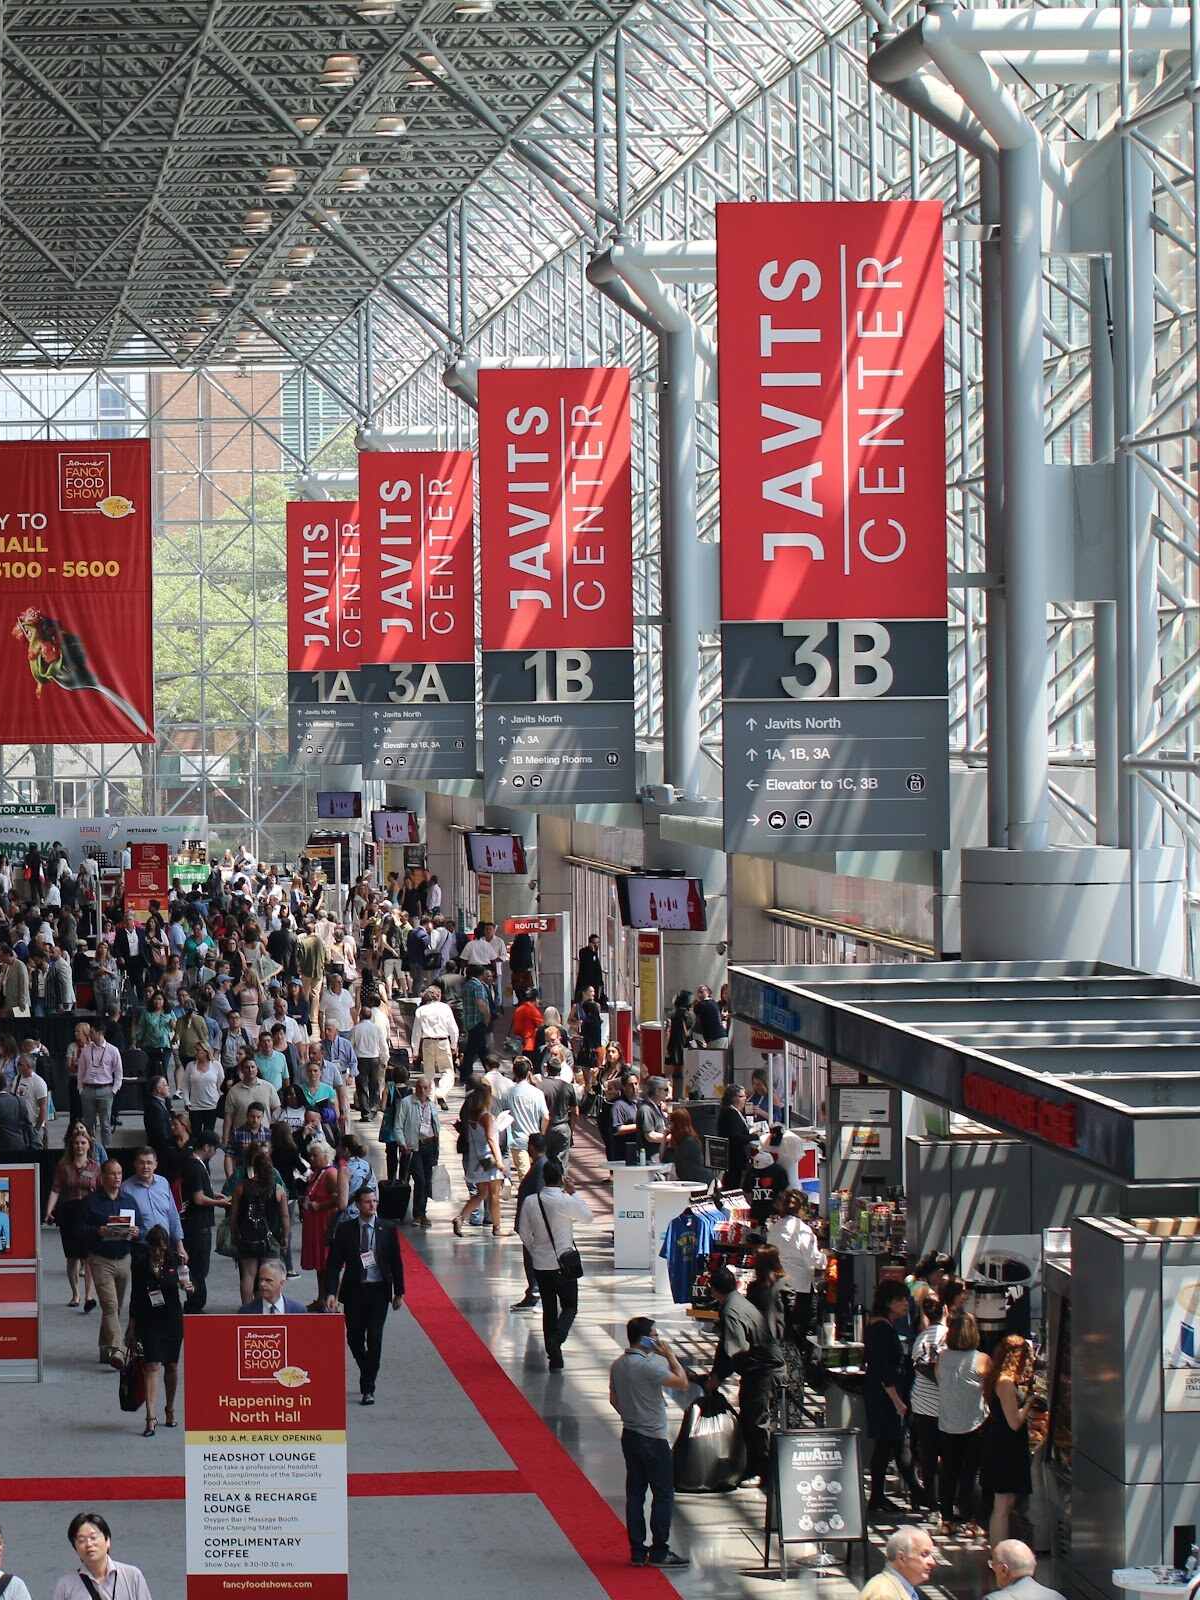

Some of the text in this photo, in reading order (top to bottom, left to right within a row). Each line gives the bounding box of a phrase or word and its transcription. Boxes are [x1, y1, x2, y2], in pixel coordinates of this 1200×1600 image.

[758, 259, 824, 561] JAVITS
[856, 256, 906, 563] CENTER
[66, 468, 104, 477] FANCY
[66, 478, 104, 488] FOOD
[66, 489, 104, 498] SHOW
[506, 406, 551, 609] JAVITS
[571, 404, 606, 611] CENTER
[17, 513, 48, 530] TO
[379, 480, 414, 633] JAVITS
[428, 478, 456, 635] CENTER
[62, 561, 119, 577] 5600
[302, 523, 330, 647] JAVITS
[342, 523, 362, 648] CENTER
[780, 622, 894, 698] 3B
[524, 650, 594, 702] 1B
[310, 672, 360, 702] 1A
[388, 664, 450, 702] 3A
[403, 710, 422, 718] North
[511, 714, 562, 724] Javits North
[765, 717, 840, 730] Javits North
[512, 736, 539, 745] 1A, 3A
[766, 748, 830, 761] 1A, 1B, 3A
[512, 756, 592, 766] 1B Meeting Rooms
[766, 778, 878, 791] Elevator to 1C, 3B
[540, 920, 548, 930] 3
[754, 1178, 759, 1188] I
[752, 1189, 772, 1200] NY
[244, 1340, 280, 1348] FANCY
[244, 1350, 280, 1359] FOOD
[244, 1360, 280, 1368] SHOW
[218, 1395, 312, 1408] Happening in
[230, 1412, 300, 1422] North Hall
[204, 1454, 265, 1462] HEADSHOT
[792, 1448, 842, 1461] LAVAZZA
[204, 1494, 240, 1502] RELAX
[256, 1493, 317, 1501] RECHARGE
[205, 1505, 250, 1513] LOUNGE
[205, 1538, 301, 1546] COMPLIMENTARY
[205, 1550, 249, 1558] COFFEE
[223, 1580, 312, 1589] fancyfoodshows.com
